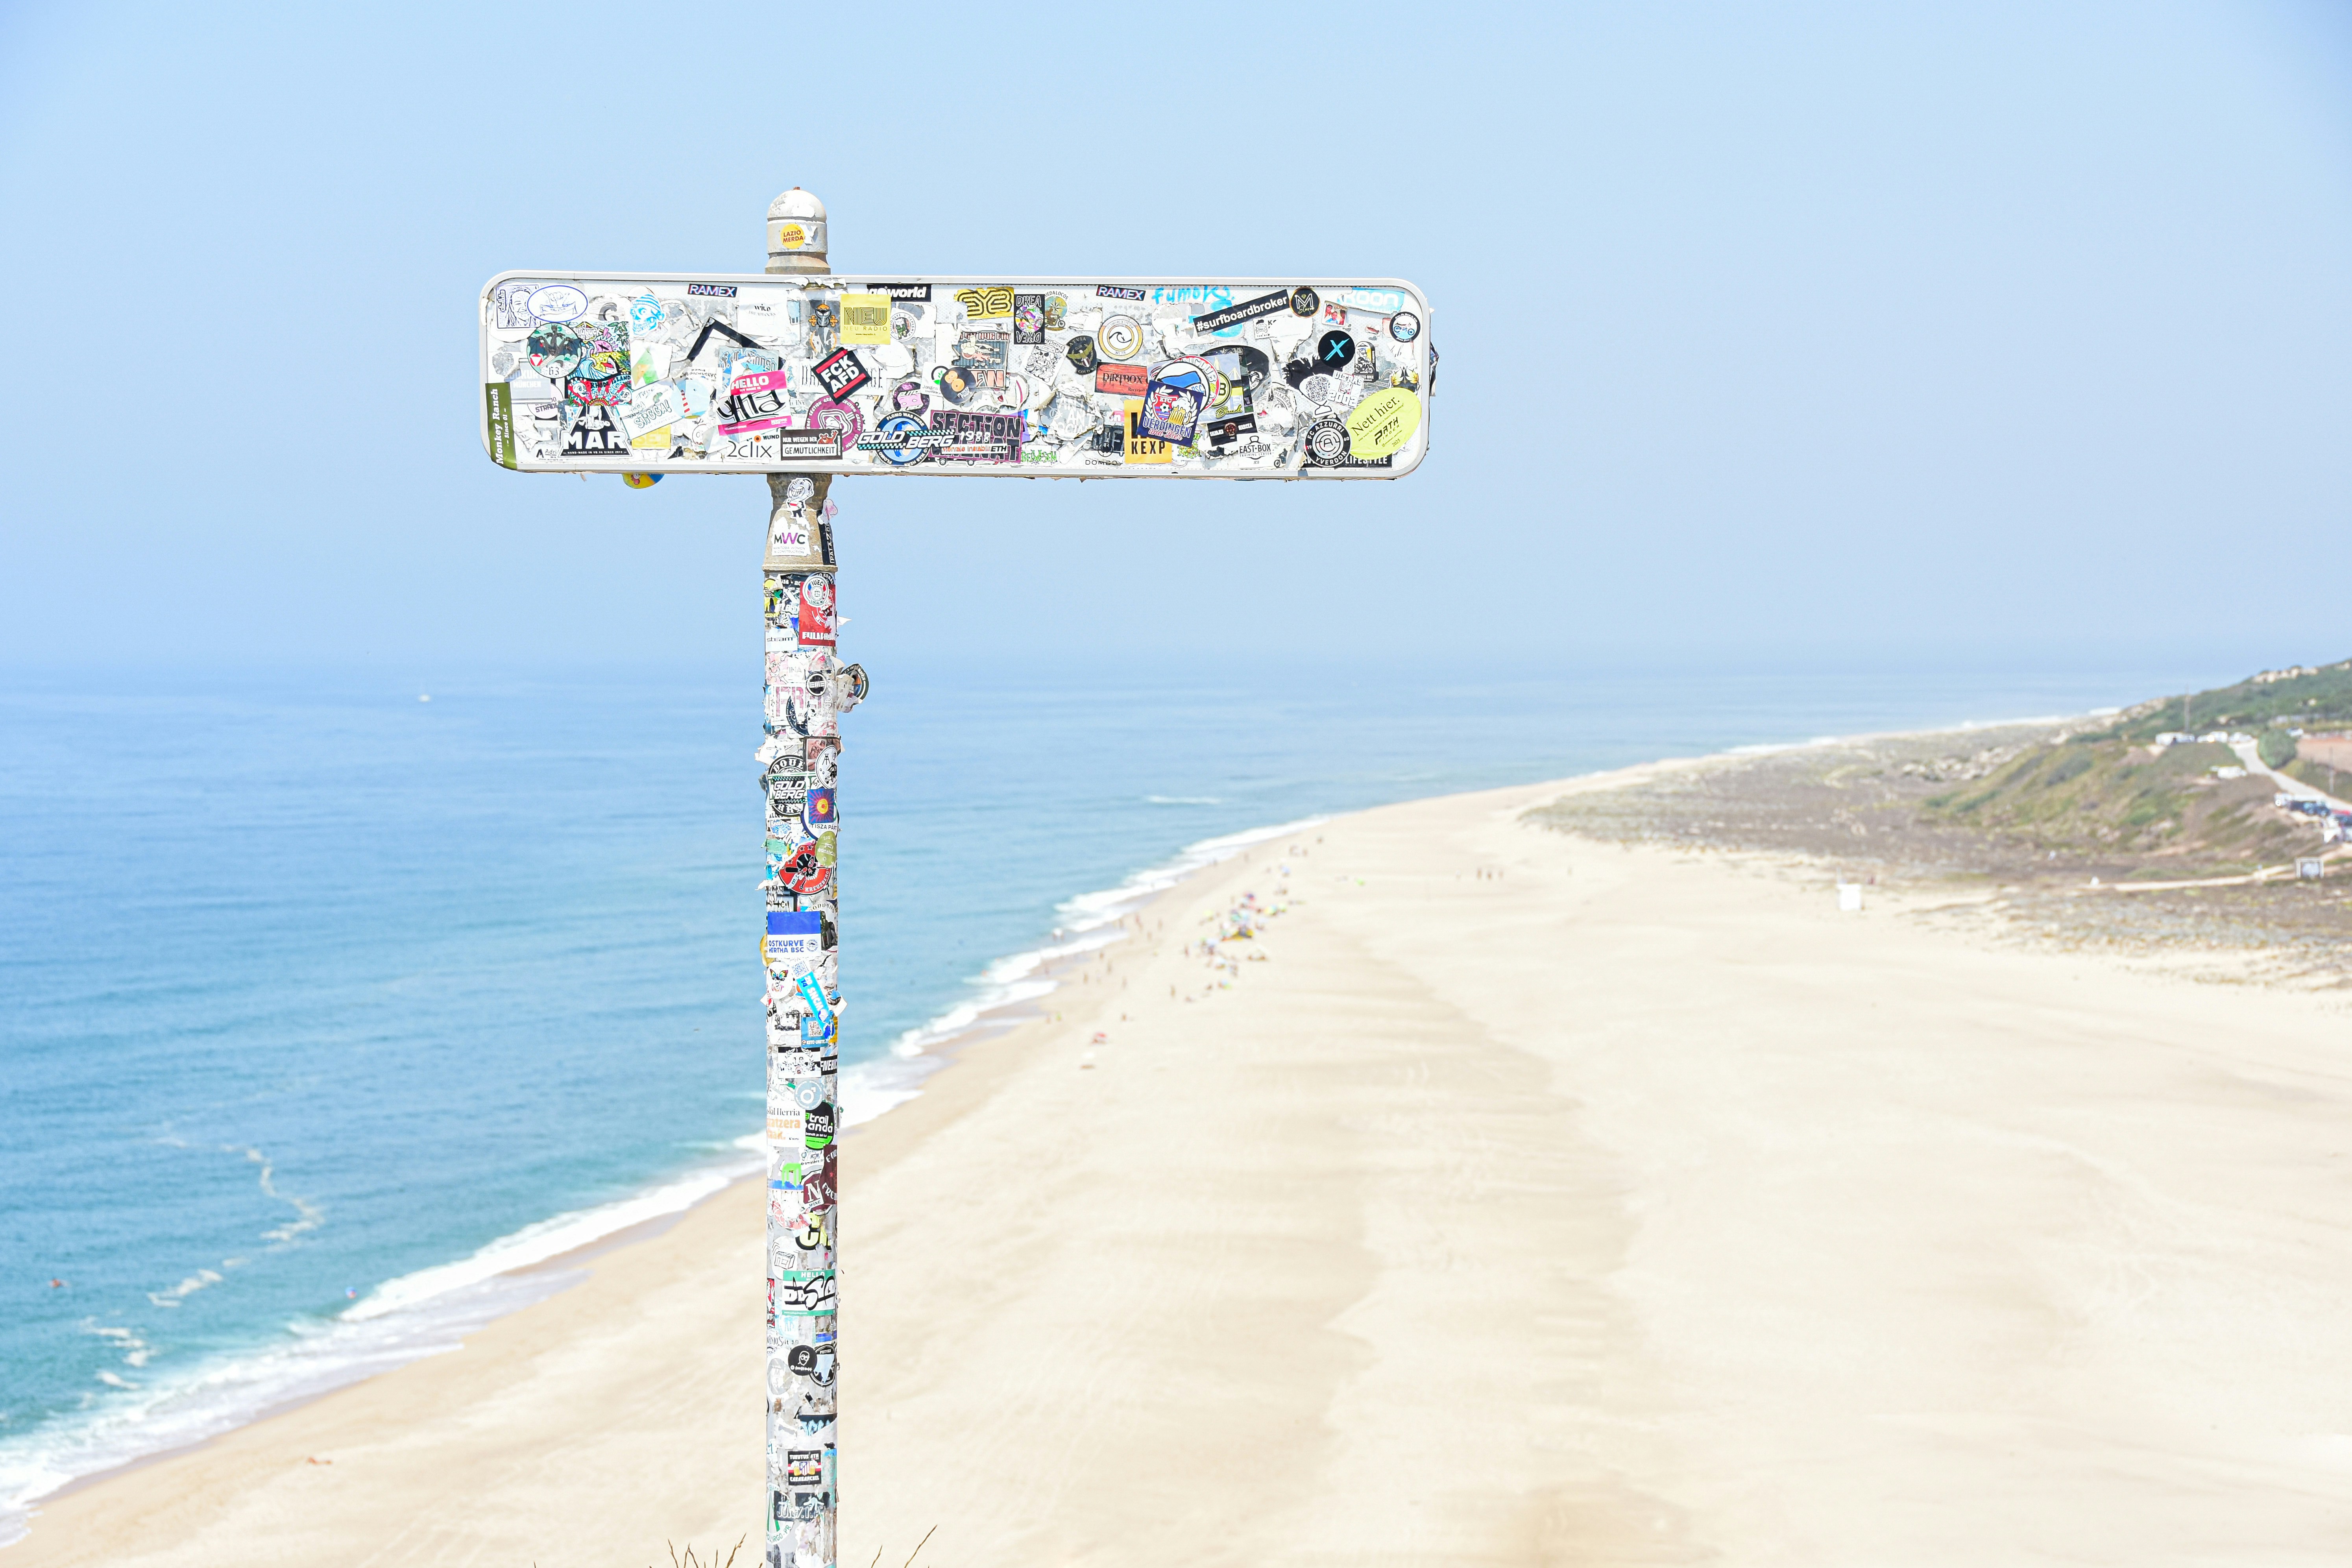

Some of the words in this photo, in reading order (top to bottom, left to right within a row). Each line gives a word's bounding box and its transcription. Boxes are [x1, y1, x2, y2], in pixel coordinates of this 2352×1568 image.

[689, 284, 736, 297] RAMEX
[1098, 287, 1144, 300] RAMEX
[1016, 296, 1042, 307] DREA
[844, 307, 887, 325] NEU
[1196, 296, 1288, 331] #surfboardbroker
[1016, 332, 1041, 343] DREA
[1070, 337, 1086, 346] ATVIA
[820, 355, 854, 383] FCK
[612, 375, 631, 385] ISLAND
[731, 375, 769, 390] HELLO
[830, 366, 859, 393] AFD
[1334, 373, 1363, 386] ULTRAS
[491, 388, 500, 420] Ranch
[1328, 390, 1358, 408] 2002
[913, 416, 925, 427] HERE
[1350, 414, 1376, 436] Nett
[1374, 397, 1400, 417] hier.
[1143, 417, 1192, 438] UERDINGEN
[1307, 430, 1315, 440] FC
[1315, 422, 1345, 434] AZZURRI
[1375, 417, 1398, 445] PATH
[1379, 425, 1399, 443] FINDER
[563, 432, 626, 449] MAR
[857, 431, 905, 444] GOLD
[906, 435, 955, 448] BERG
[960, 431, 991, 444] 1988
[1164, 431, 1183, 441] Bier
[495, 423, 504, 465] Monkey
[727, 440, 772, 458] 2clix
[785, 445, 835, 454] GEMÜTLICHKEIT
[1131, 441, 1165, 454] KEXP
[879, 452, 892, 464] FLOMO
[1316, 451, 1347, 465] YVERDON
[774, 532, 806, 545] MWC
[774, 781, 805, 790] GOLD
[774, 790, 805, 799] BERG
[809, 1113, 829, 1124] trail
